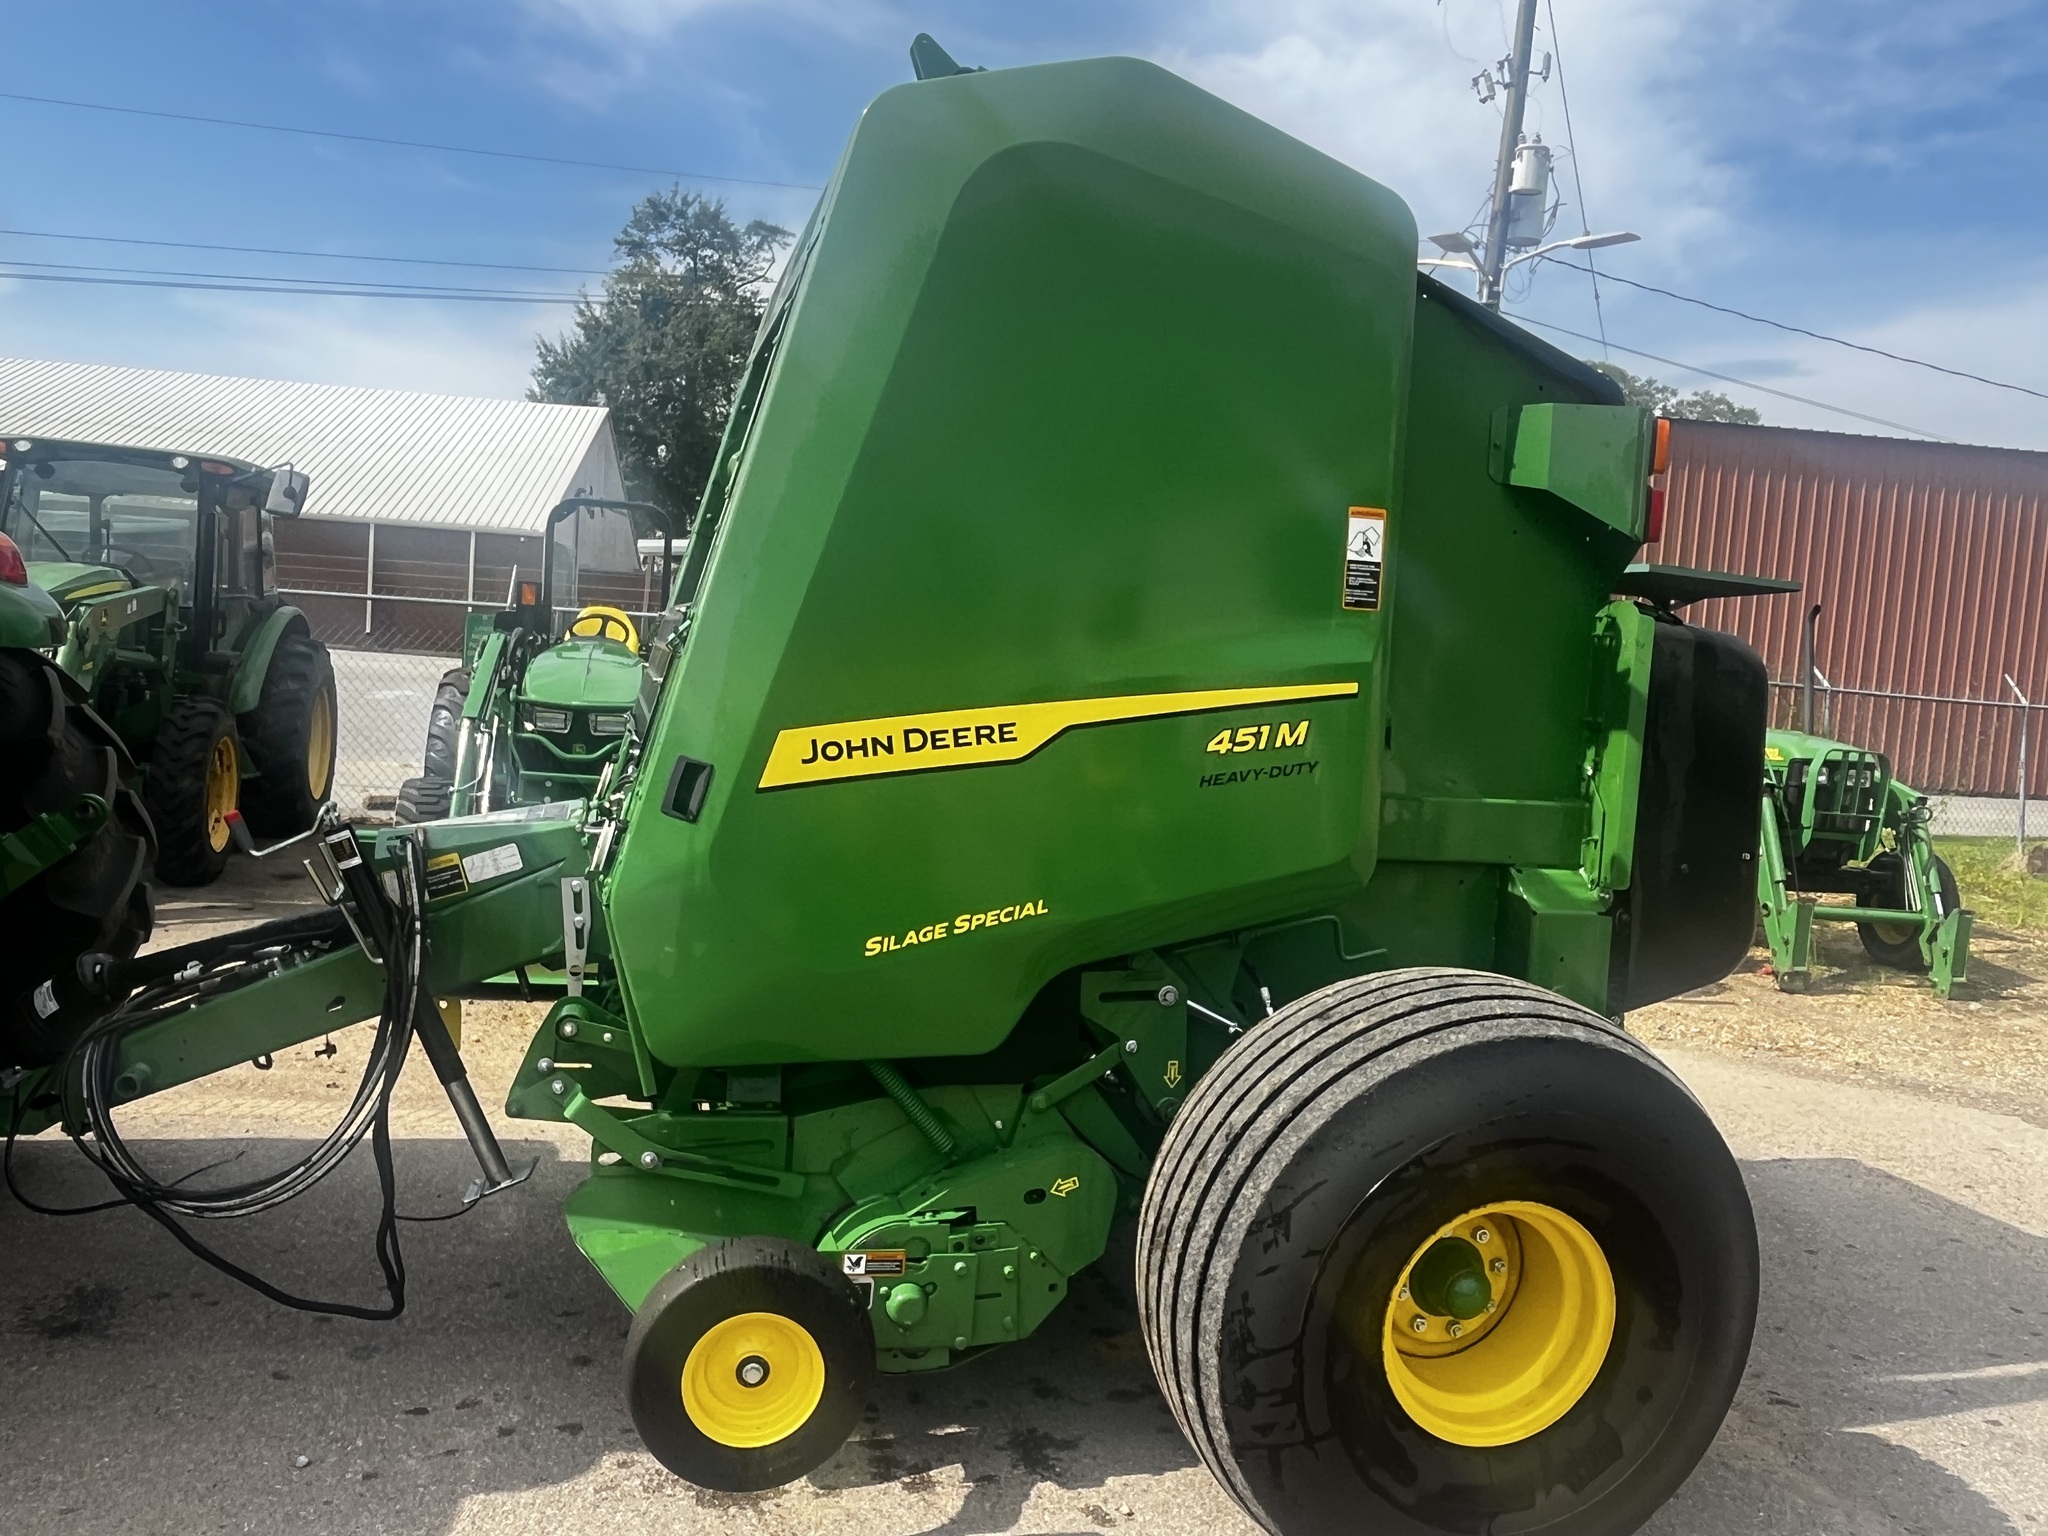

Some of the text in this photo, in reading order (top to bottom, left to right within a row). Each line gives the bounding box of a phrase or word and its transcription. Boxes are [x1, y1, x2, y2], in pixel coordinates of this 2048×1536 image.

[801, 722, 1018, 764] JOHN DEERE
[1199, 761, 1319, 788] HEAVY-DUTY
[864, 899, 1049, 957] SILAGE SPECIAL
